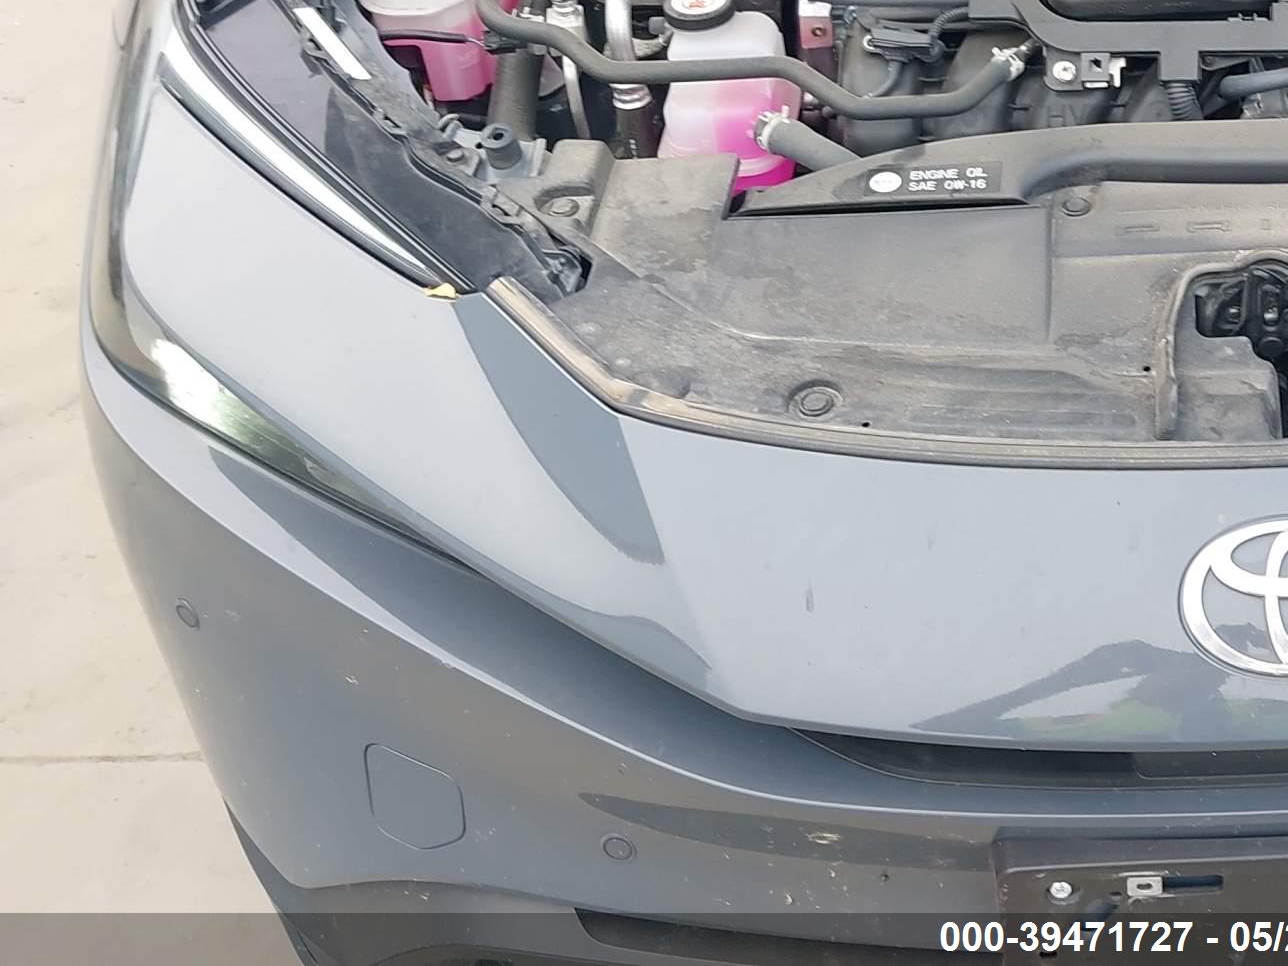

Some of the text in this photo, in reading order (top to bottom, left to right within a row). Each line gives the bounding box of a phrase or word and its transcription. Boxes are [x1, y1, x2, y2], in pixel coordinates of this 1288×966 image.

[909, 166, 989, 181] ENGINE OIL
[908, 179, 987, 191] SAE 0W-16
